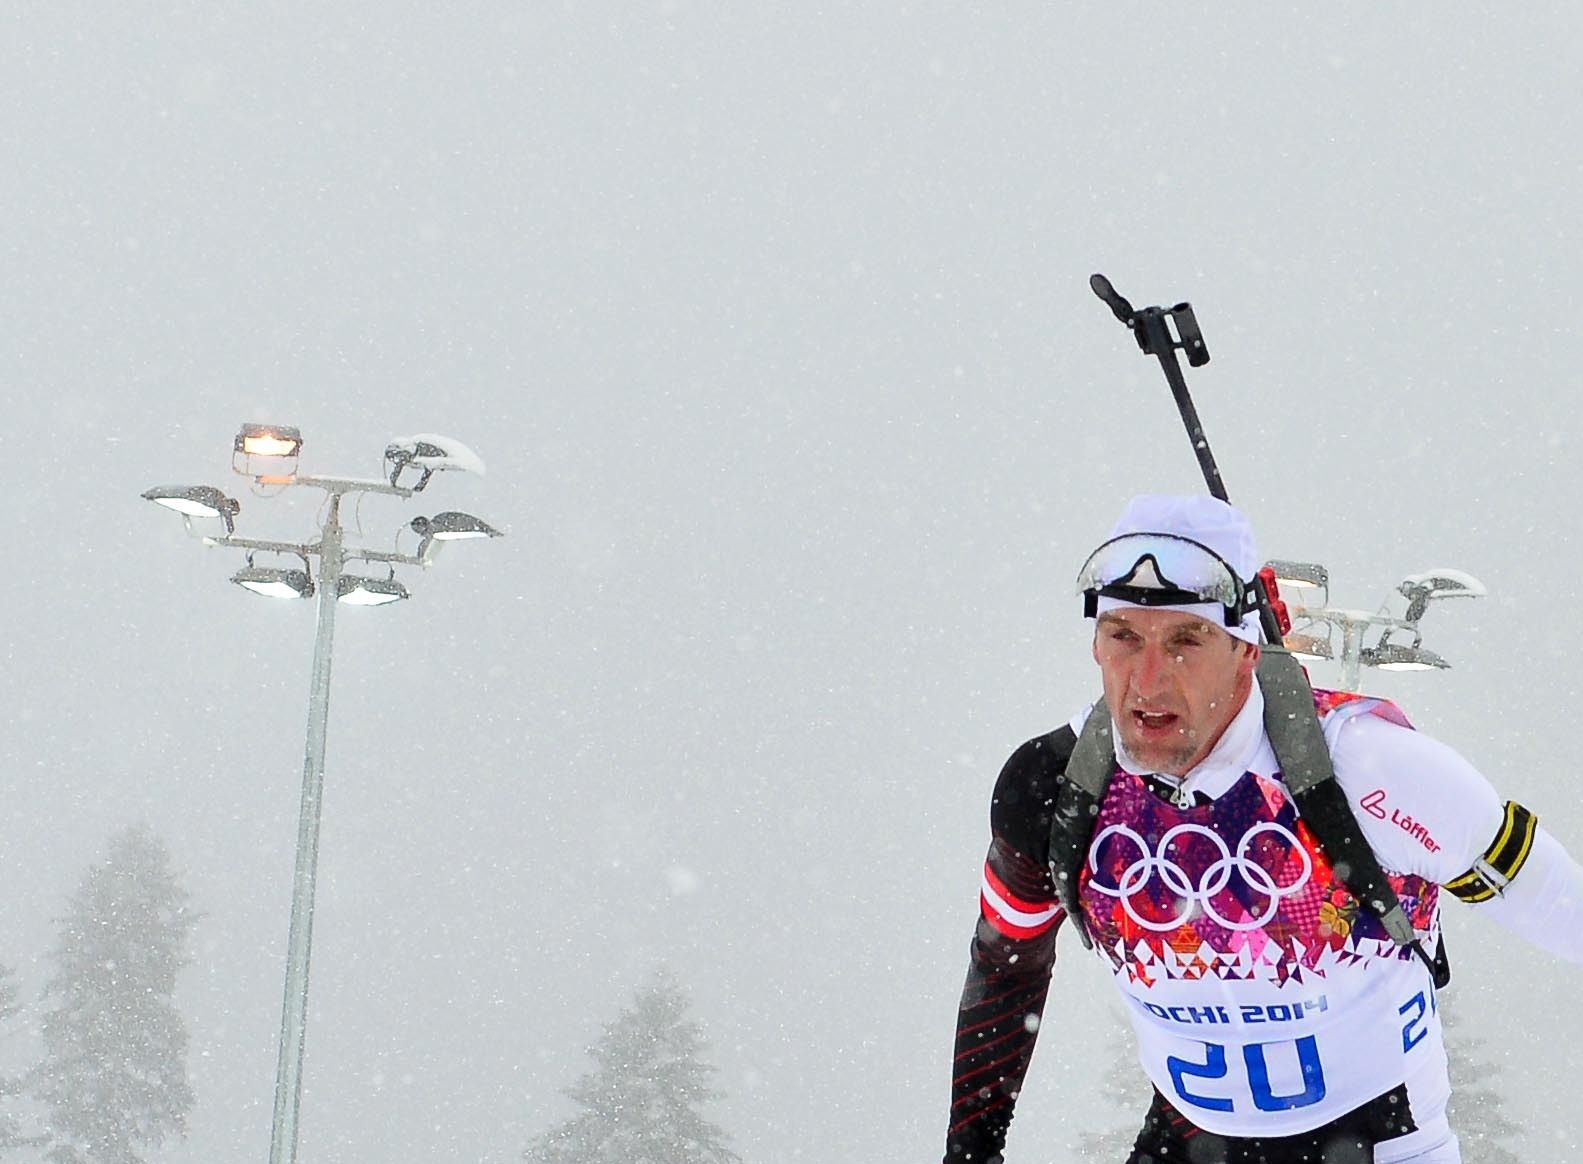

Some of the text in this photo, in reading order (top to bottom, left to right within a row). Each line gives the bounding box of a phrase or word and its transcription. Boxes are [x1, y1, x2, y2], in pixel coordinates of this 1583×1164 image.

[1391, 808, 1441, 854] Löffler
[1239, 994, 1329, 1024] 2014
[1166, 1033, 1327, 1113] 20
